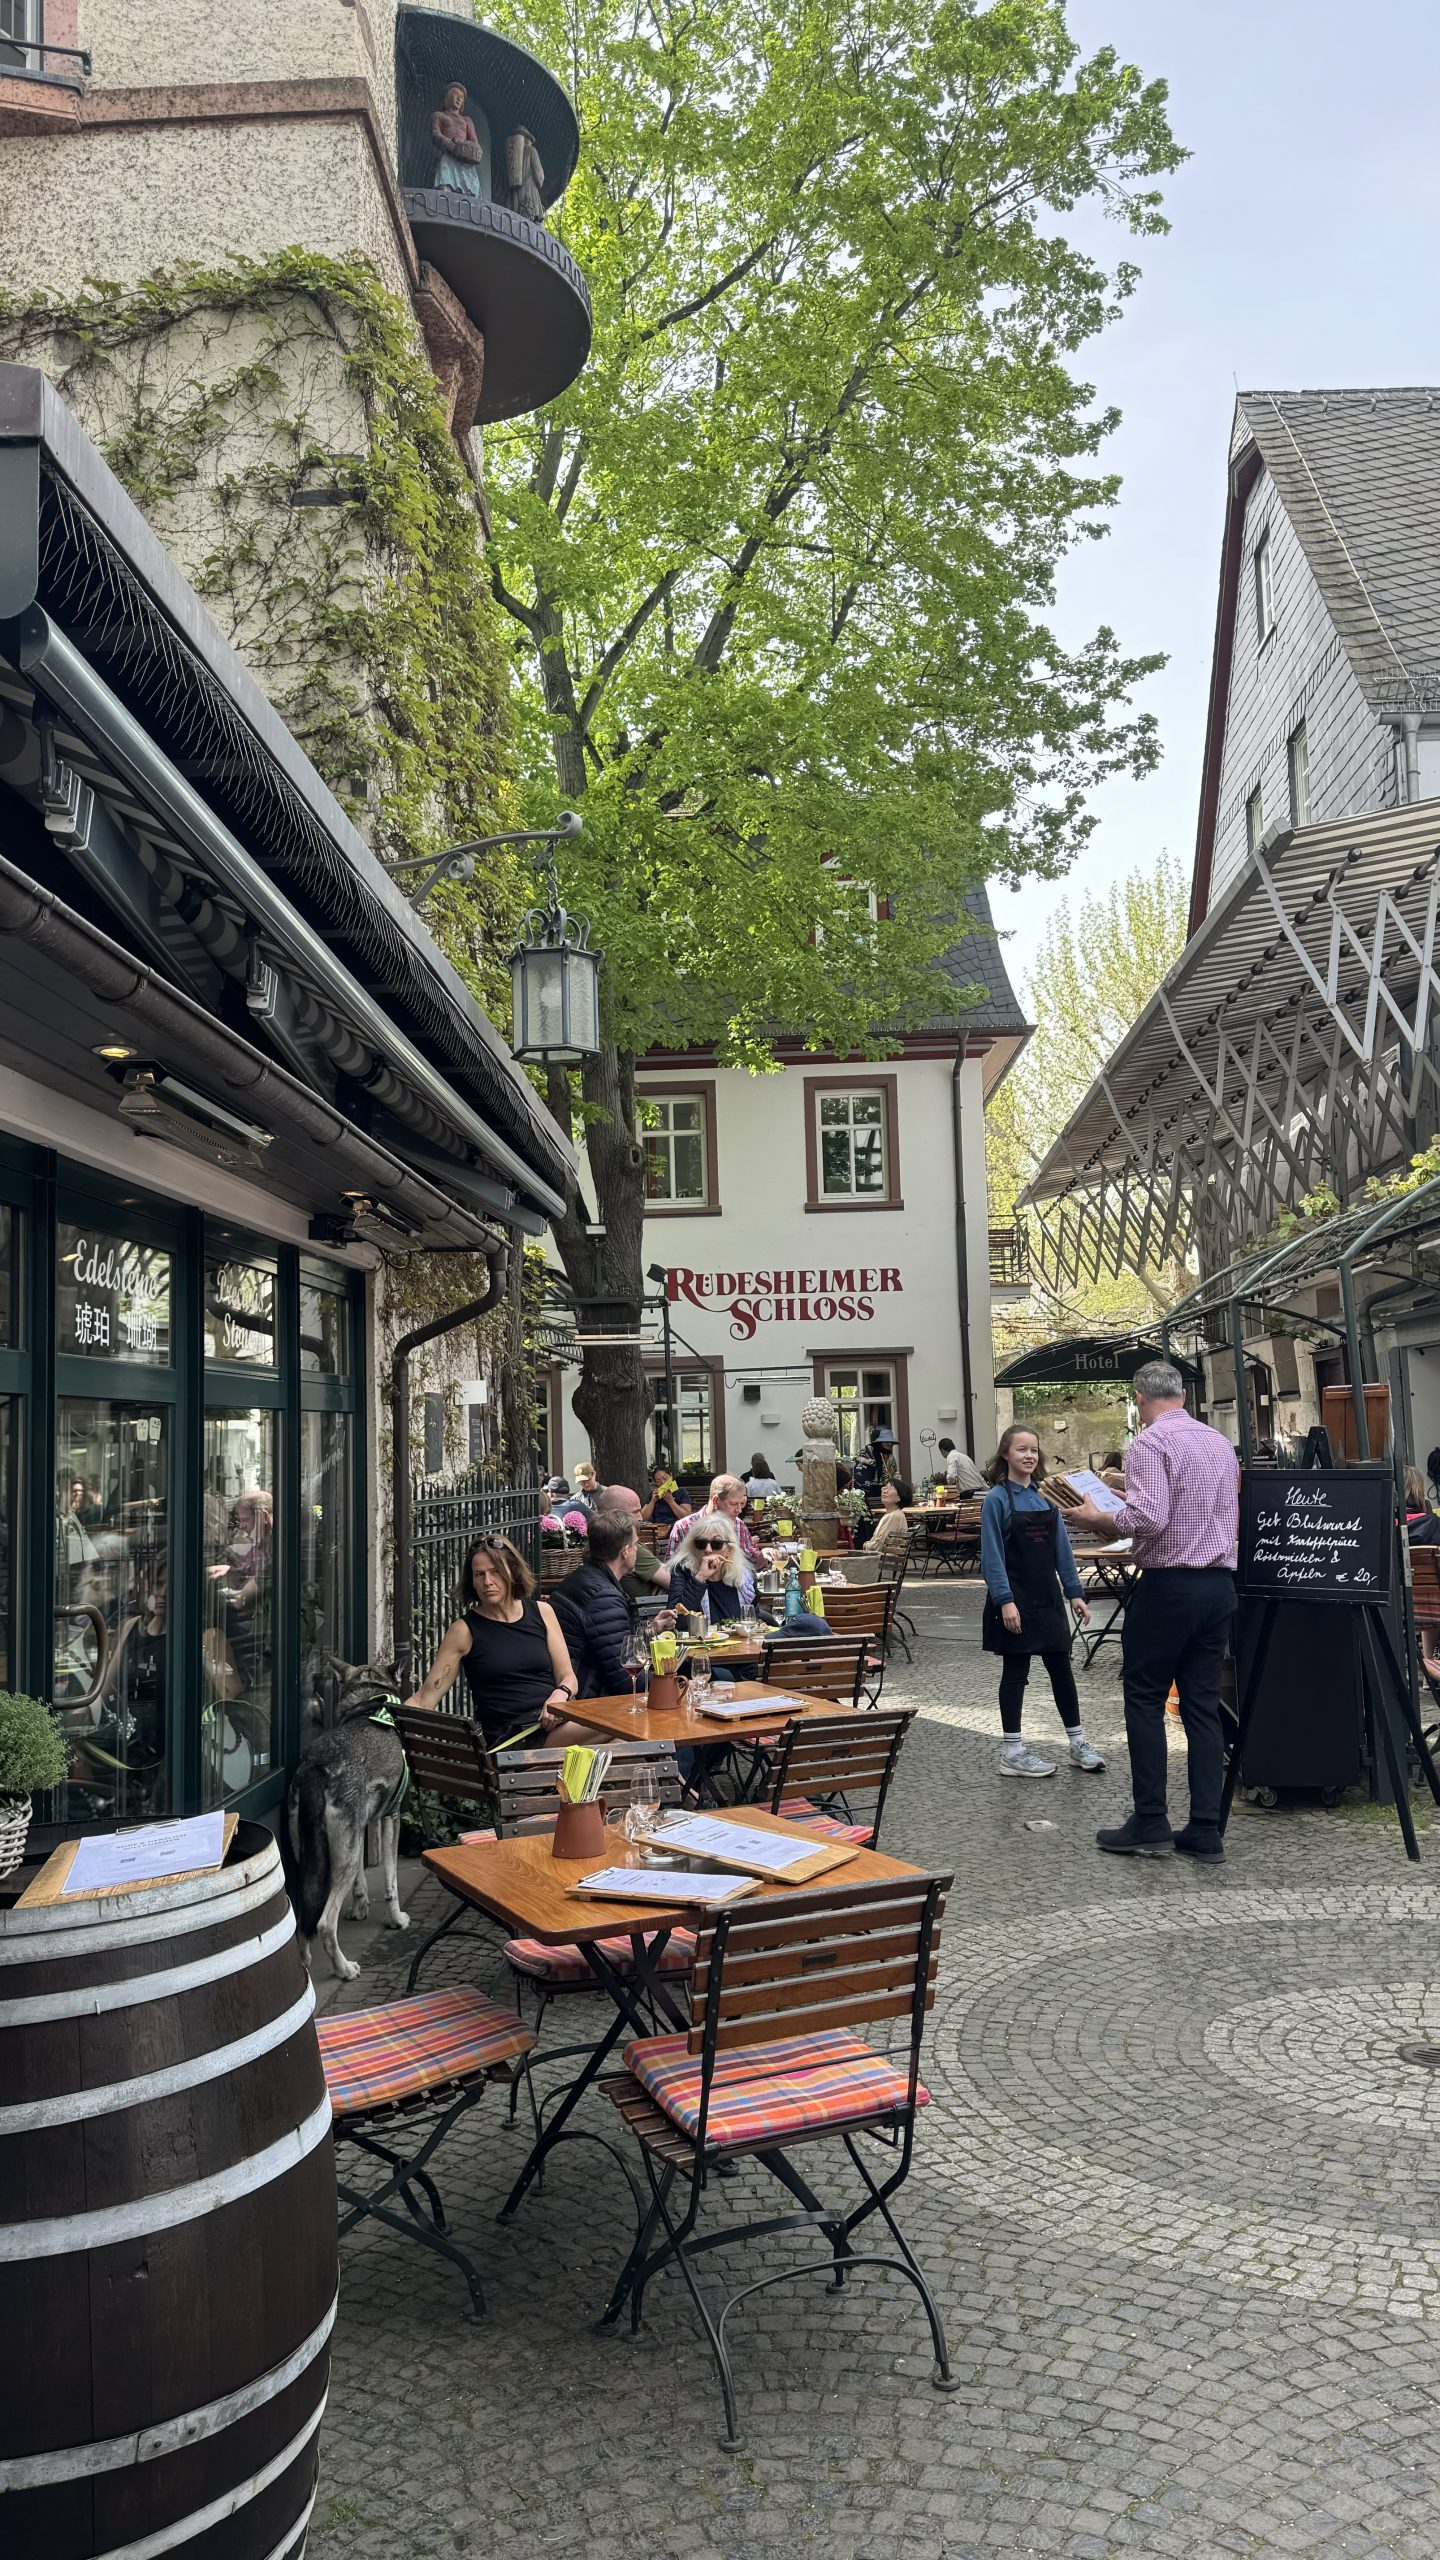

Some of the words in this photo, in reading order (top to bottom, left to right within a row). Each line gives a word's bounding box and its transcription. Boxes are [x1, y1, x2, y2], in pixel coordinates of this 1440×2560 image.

[73, 1239, 157, 1300] Edelsteine
[667, 1267, 904, 1308] RÜDESHEIMER
[75, 1301, 110, 1347] 琥珀
[126, 1311, 157, 1352] 珊瑚
[729, 1296, 875, 1341] SCHLOSS
[1074, 1353, 1120, 1370] Hotel
[1284, 1486, 1328, 1506] Heute
[1257, 1511, 1282, 1531] Geb.
[1286, 1512, 1363, 1531] Blutwurst
[1255, 1535, 1281, 1548] mit
[1286, 1534, 1361, 1551] Kartoffelpüree
[1330, 1550, 1341, 1564] &
[1276, 1563, 1327, 1584] Äpfeln
